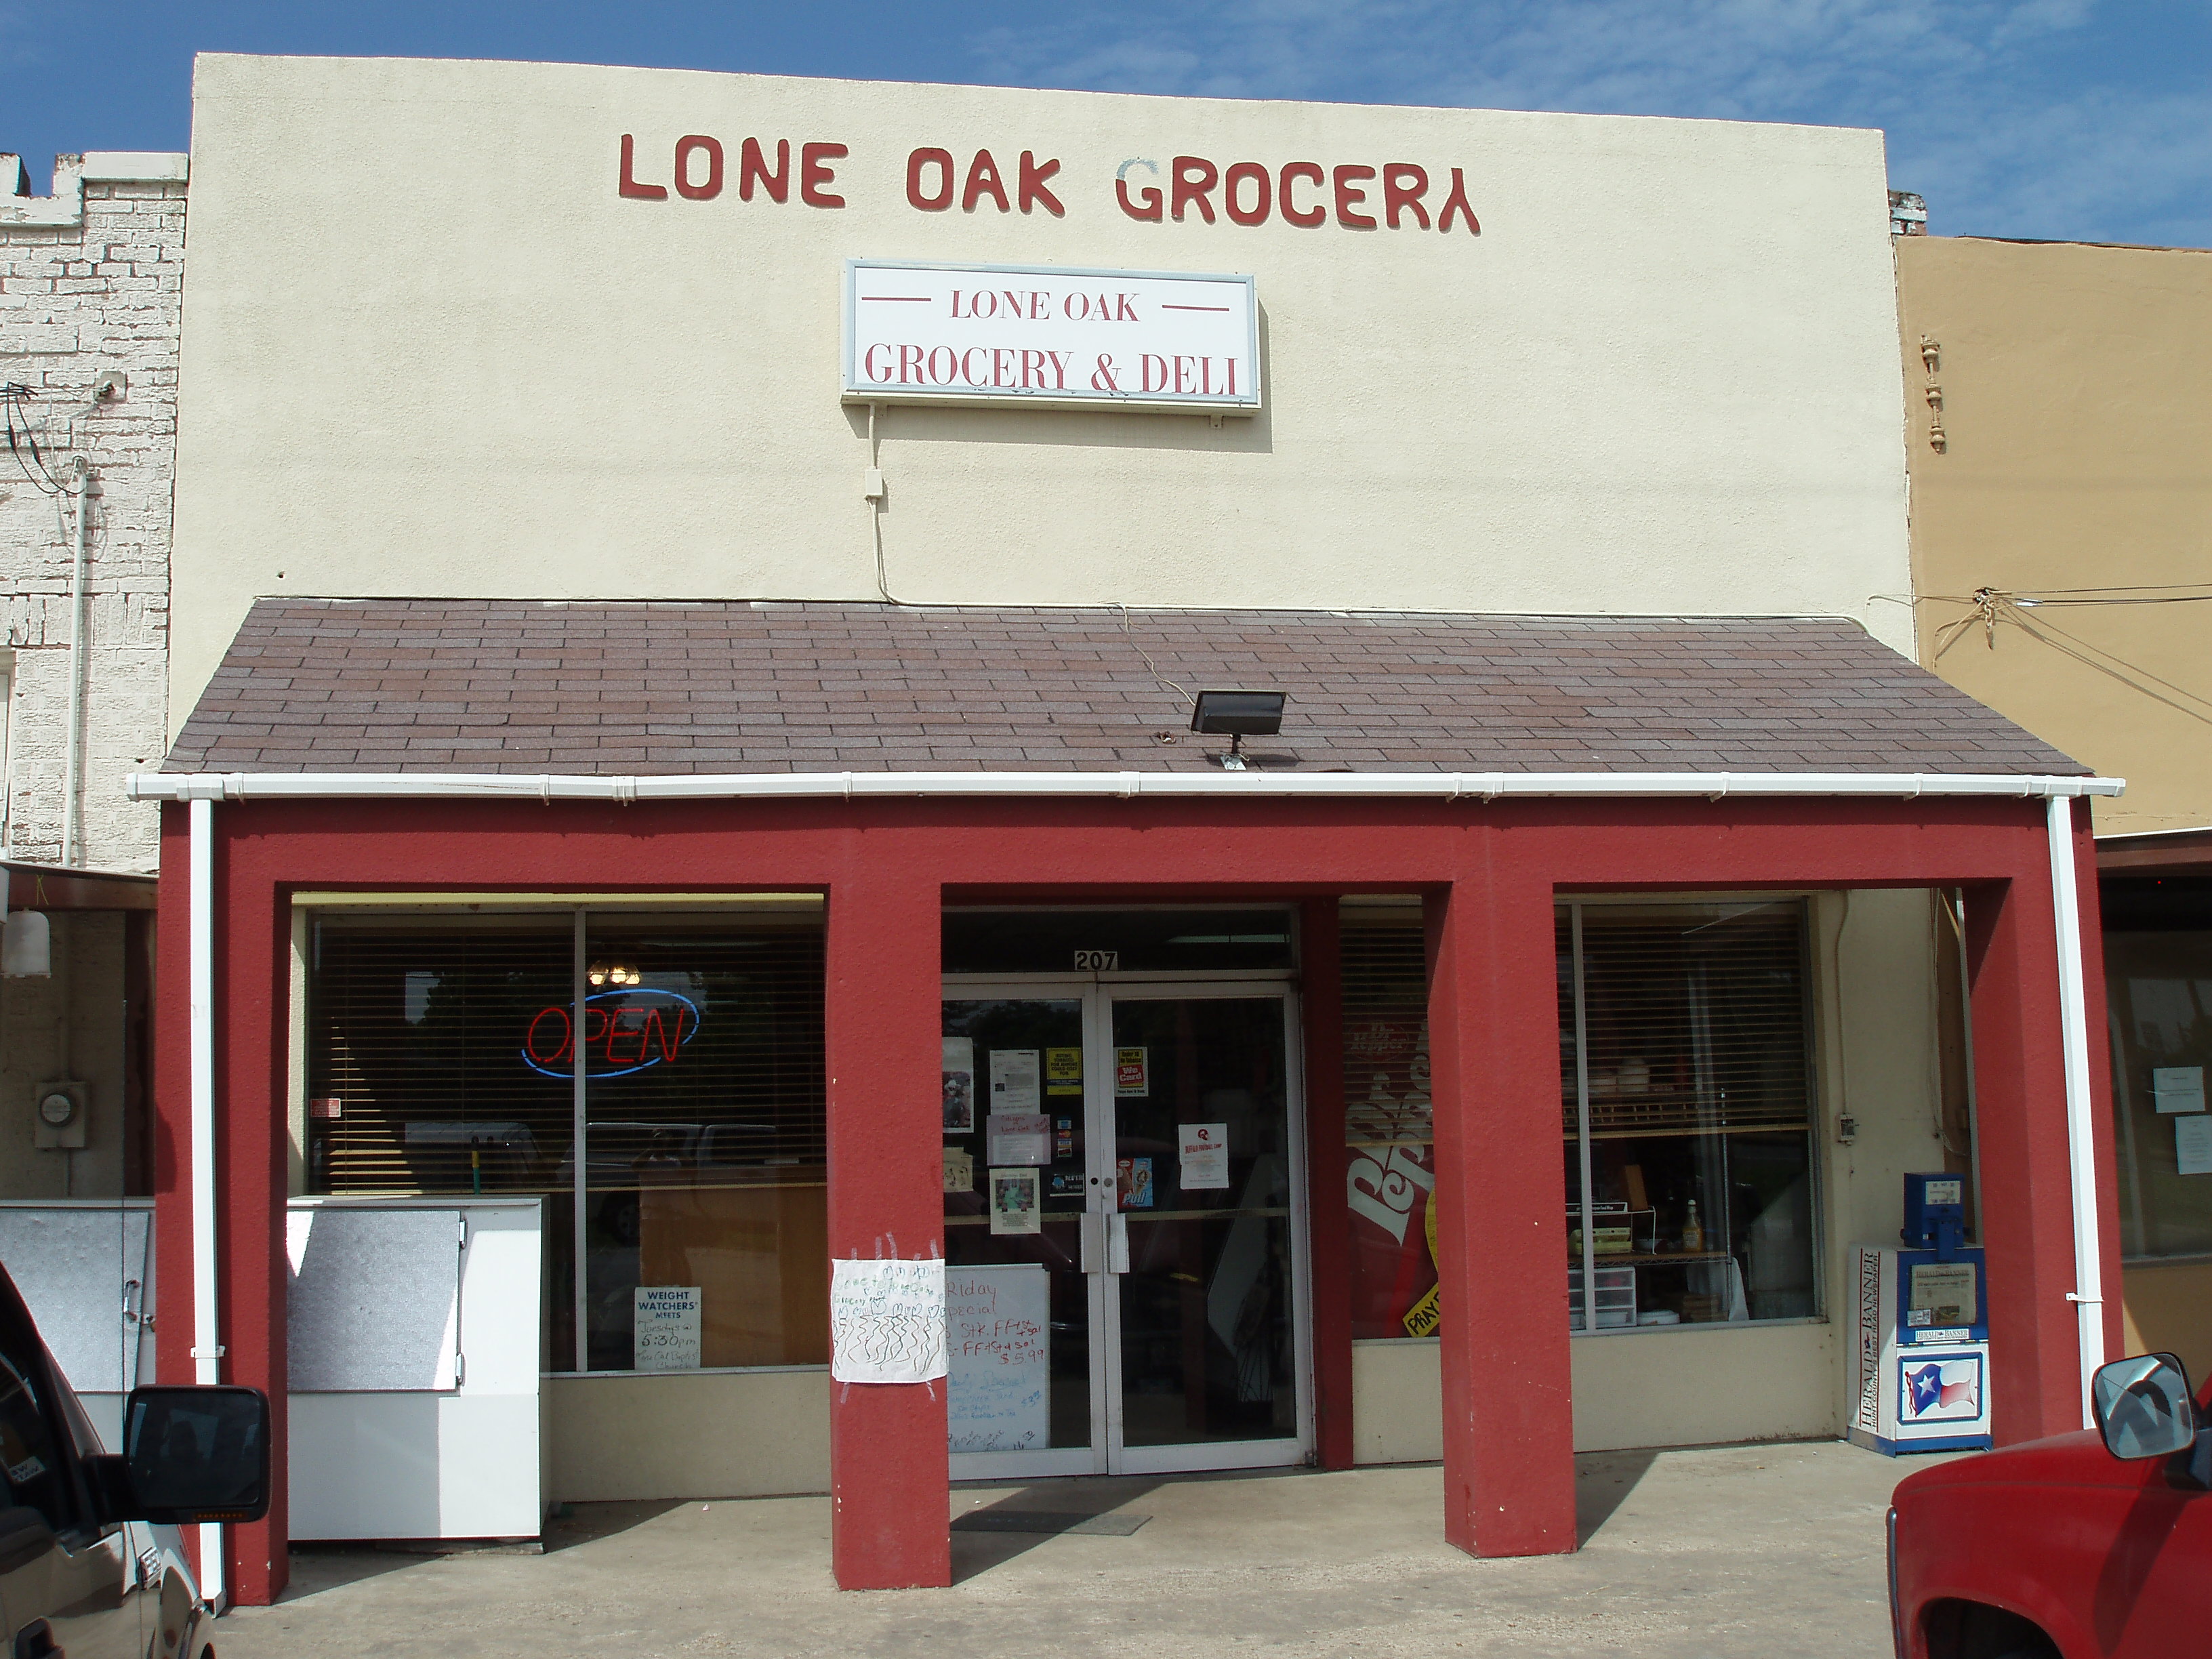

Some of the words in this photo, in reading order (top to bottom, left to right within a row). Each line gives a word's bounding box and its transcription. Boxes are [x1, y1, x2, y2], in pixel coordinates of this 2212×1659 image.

[619, 134, 848, 209] LONE
[906, 147, 1065, 218] OAK
[1115, 156, 1481, 237] GROCERY
[949, 289, 1051, 321] LONE
[1064, 291, 1141, 322] OAK
[865, 342, 1074, 390] GROCERY
[1091, 353, 1122, 392] &
[1139, 353, 1238, 396] DELI
[1077, 951, 1115, 970] 207
[528, 1006, 685, 1063] OPEN
[1119, 1072, 1143, 1082] Card
[1122, 1191, 1147, 1206] Pull
[638, 1301, 695, 1311] WATCHERS
[647, 1291, 690, 1300] WEIGHT
[1862, 1252, 1874, 1330] BANNER
[1408, 1301, 1439, 1335] PRAY
[1862, 1351, 1873, 1427] HERALD
